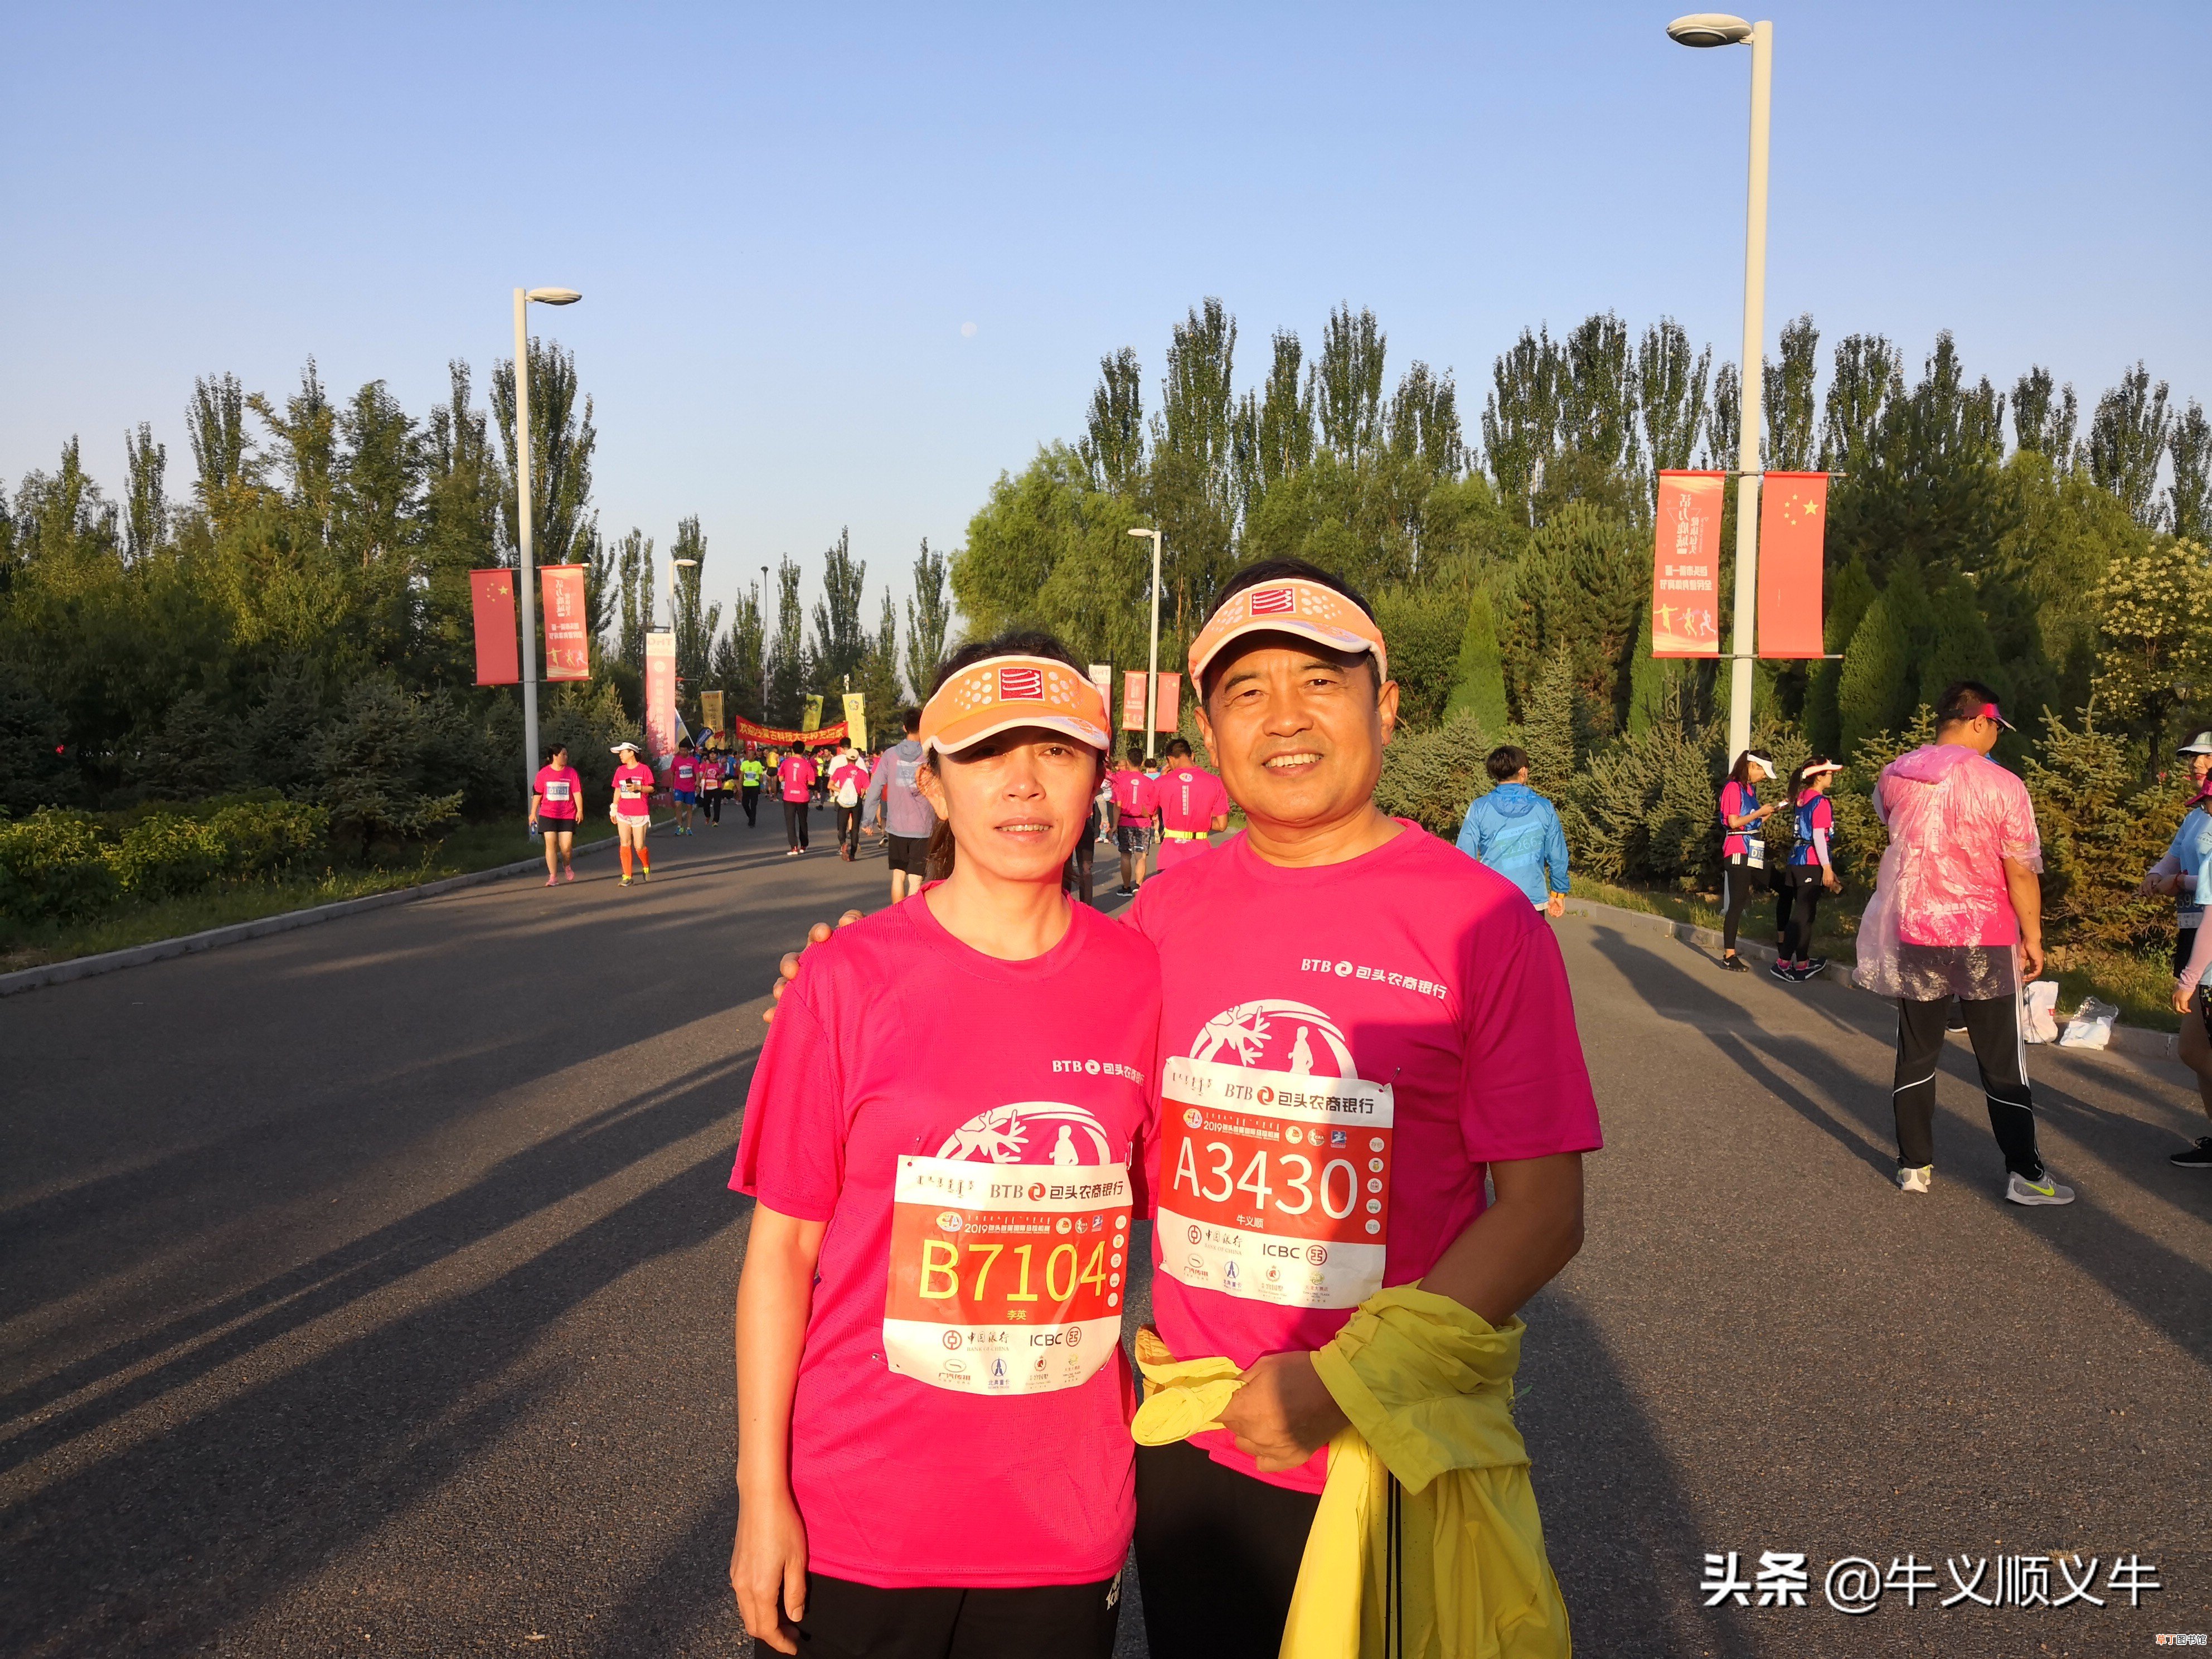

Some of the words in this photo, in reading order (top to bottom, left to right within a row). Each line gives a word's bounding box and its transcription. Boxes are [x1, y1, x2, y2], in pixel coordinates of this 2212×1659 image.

[1301, 958, 1332, 973] BTB
[1355, 966, 1448, 1000] 包头农商银行
[1052, 1060, 1083, 1073] BTB
[1224, 1083, 1253, 1101] BTB
[1278, 1091, 1374, 1114] 包头农商银行
[1173, 1136, 1358, 1219] A3430
[990, 1185, 1023, 1199] BTB
[1050, 1181, 1124, 1200] 包头农商银行
[1236, 1214, 1264, 1229] 牛义顺
[1204, 1229, 1243, 1248] 中国银行
[1262, 1243, 1300, 1259] ICBC
[919, 1239, 1107, 1302] B7104
[1007, 1309, 1027, 1321] 李英
[967, 1330, 1010, 1345] 中国银行
[1030, 1332, 1063, 1347] ICBC
